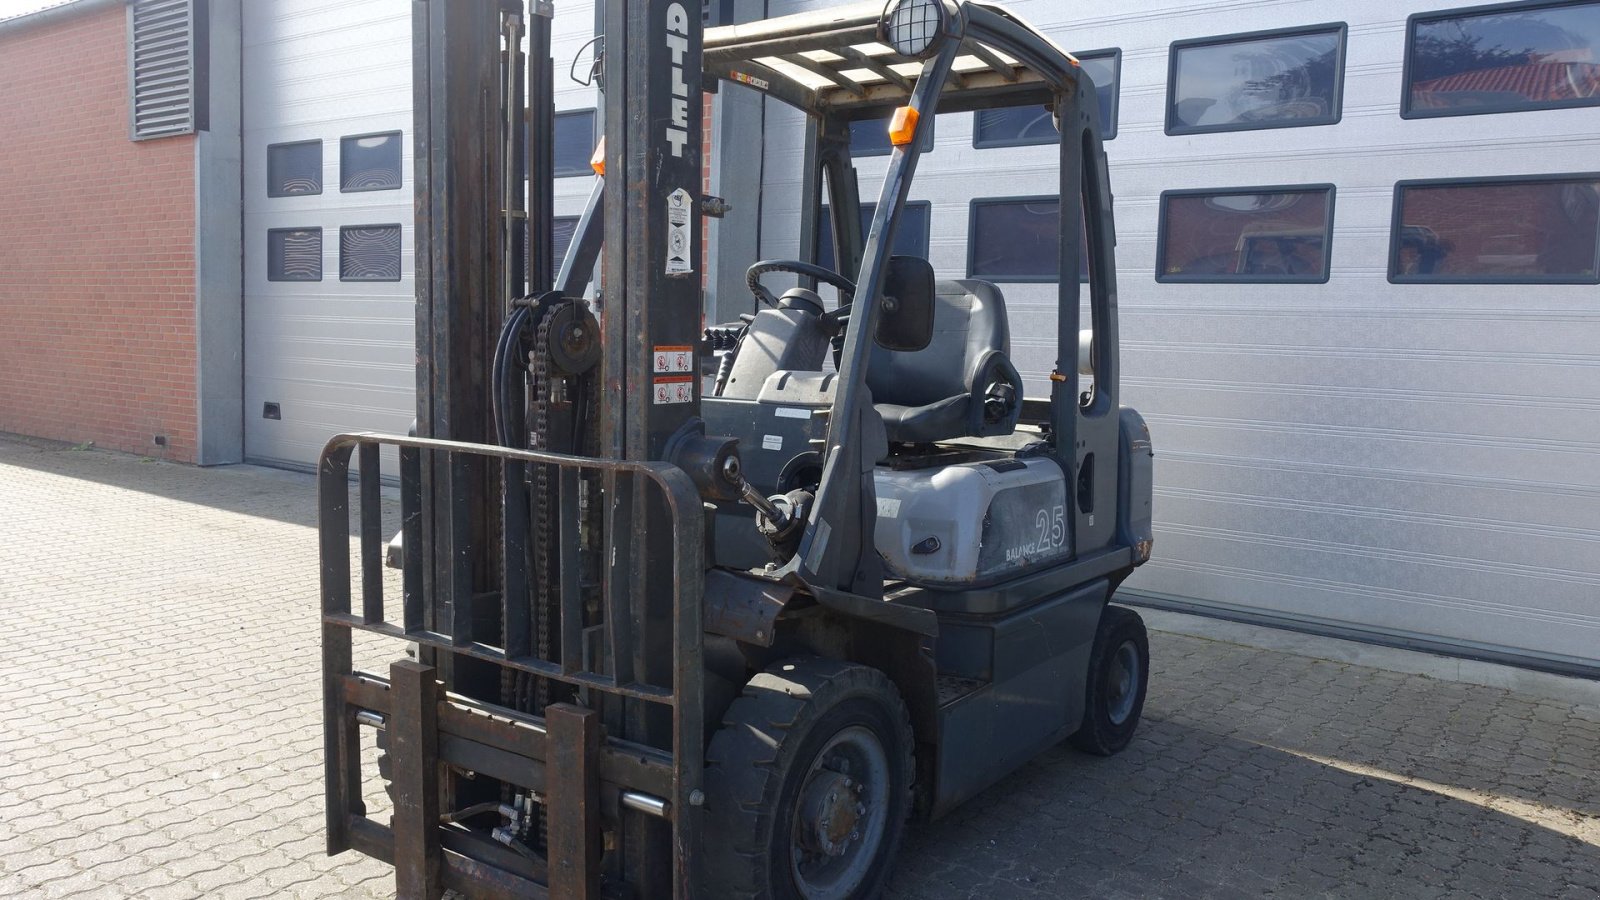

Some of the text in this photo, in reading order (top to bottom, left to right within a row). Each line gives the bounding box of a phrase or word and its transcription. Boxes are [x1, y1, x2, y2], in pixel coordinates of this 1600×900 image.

[666, 2, 689, 157] ATLET
[1006, 505, 1065, 561] BALANCE 25
